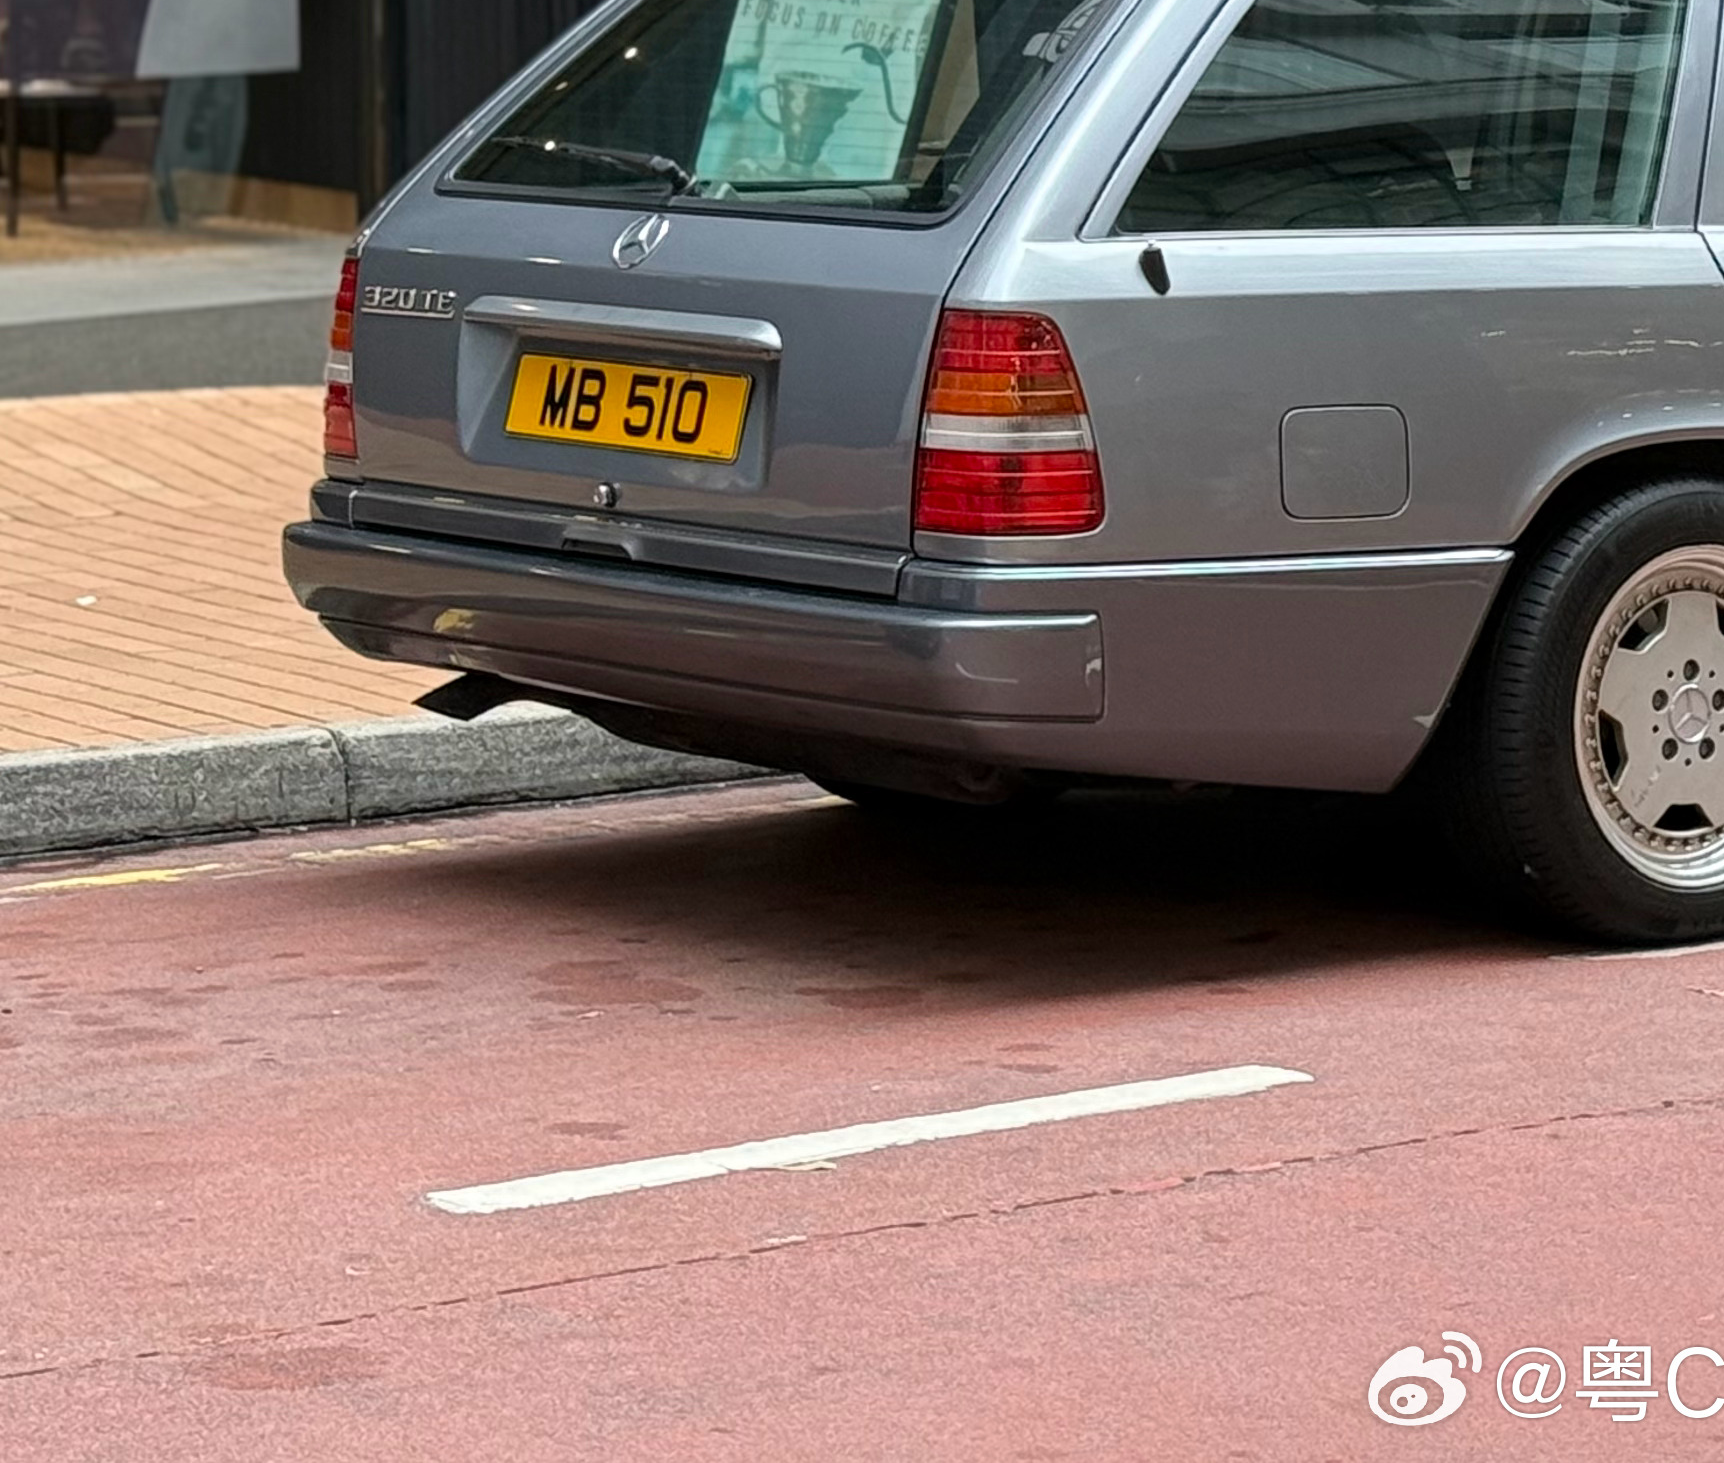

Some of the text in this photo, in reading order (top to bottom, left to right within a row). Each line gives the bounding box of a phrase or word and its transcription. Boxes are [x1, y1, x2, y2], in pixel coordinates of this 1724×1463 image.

[815, 10, 843, 37] ON
[539, 363, 709, 444] MB 510
